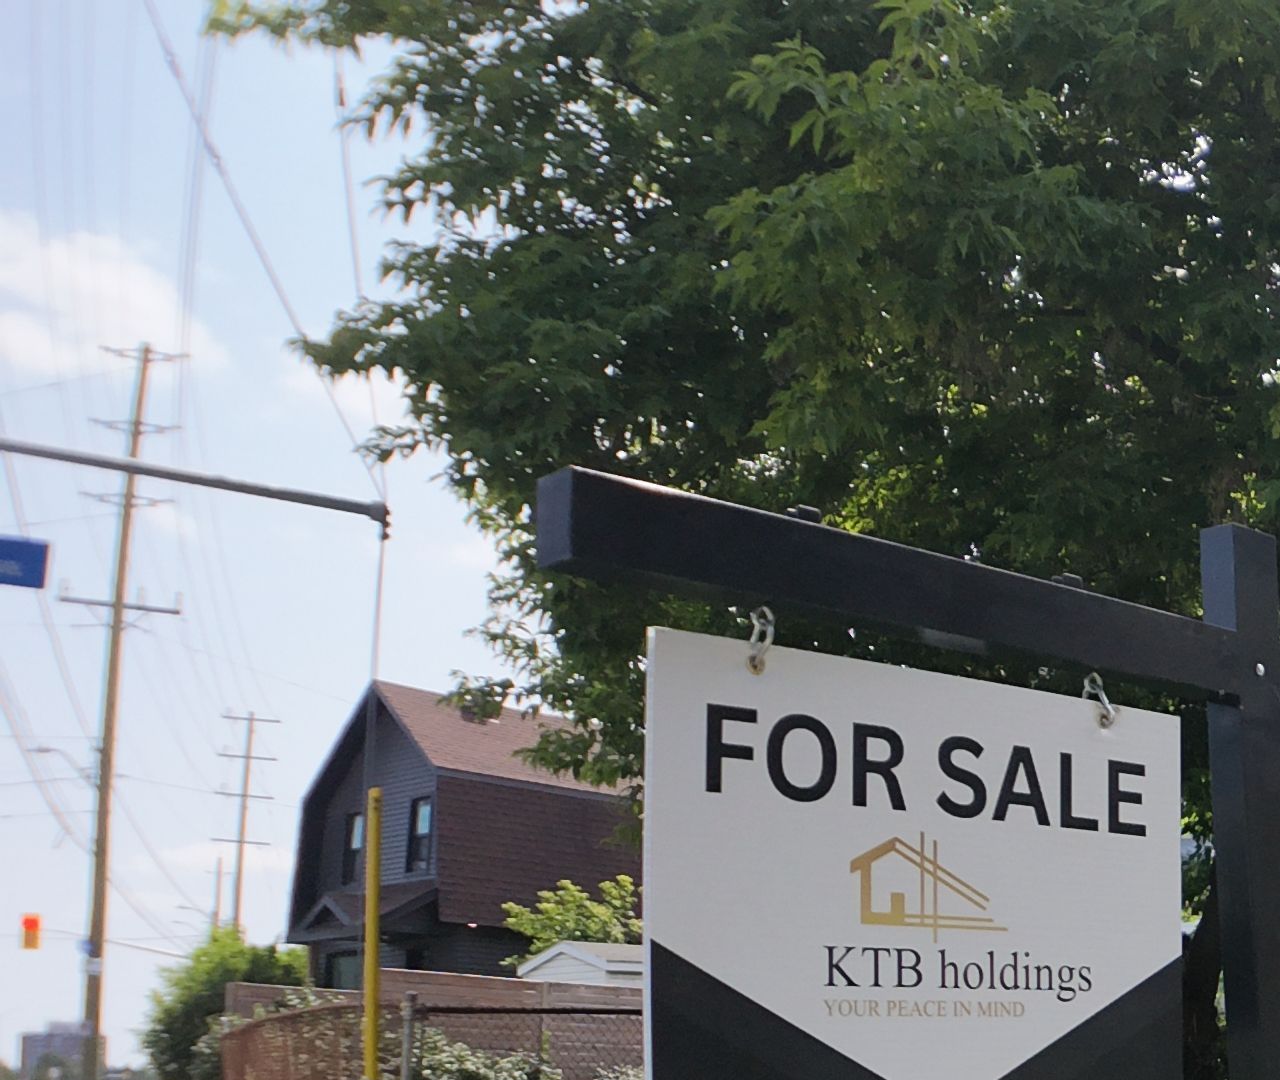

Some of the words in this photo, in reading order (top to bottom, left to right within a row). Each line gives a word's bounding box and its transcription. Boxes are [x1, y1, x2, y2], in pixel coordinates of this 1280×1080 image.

[705, 703, 906, 811] FOR
[935, 735, 1147, 837] SALE
[824, 945, 923, 989] KTB
[938, 949, 1092, 1002] holdings
[824, 999, 880, 1018] YOUR
[886, 1000, 947, 1018] PEACE
[952, 1001, 971, 1018] IN
[976, 1001, 1025, 1018] MIND
